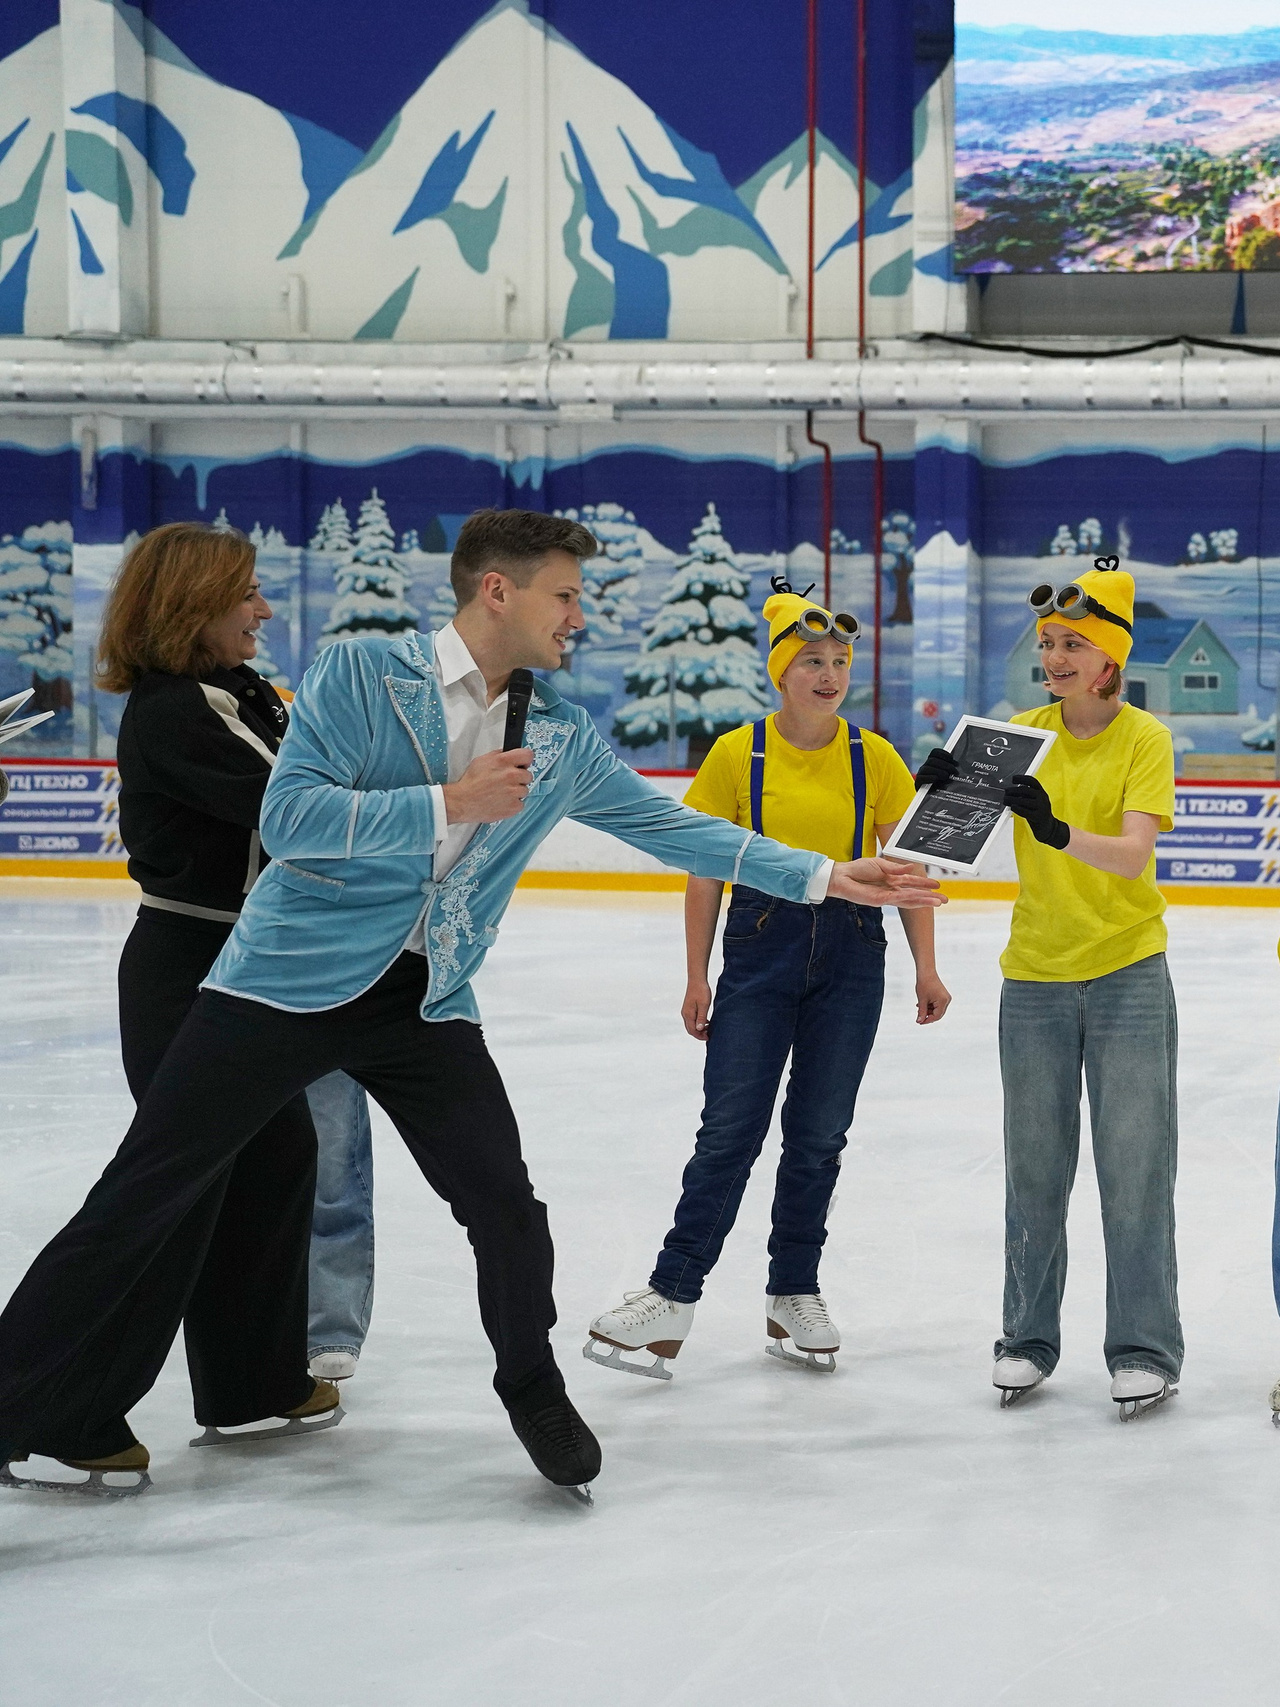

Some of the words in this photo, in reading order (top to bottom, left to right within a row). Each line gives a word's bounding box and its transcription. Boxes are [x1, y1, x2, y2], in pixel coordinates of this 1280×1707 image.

[971, 761, 999, 772] ГРАМОТА
[33, 774, 89, 790] ТЕХНО
[1188, 799, 1249, 815] ТЕХНО
